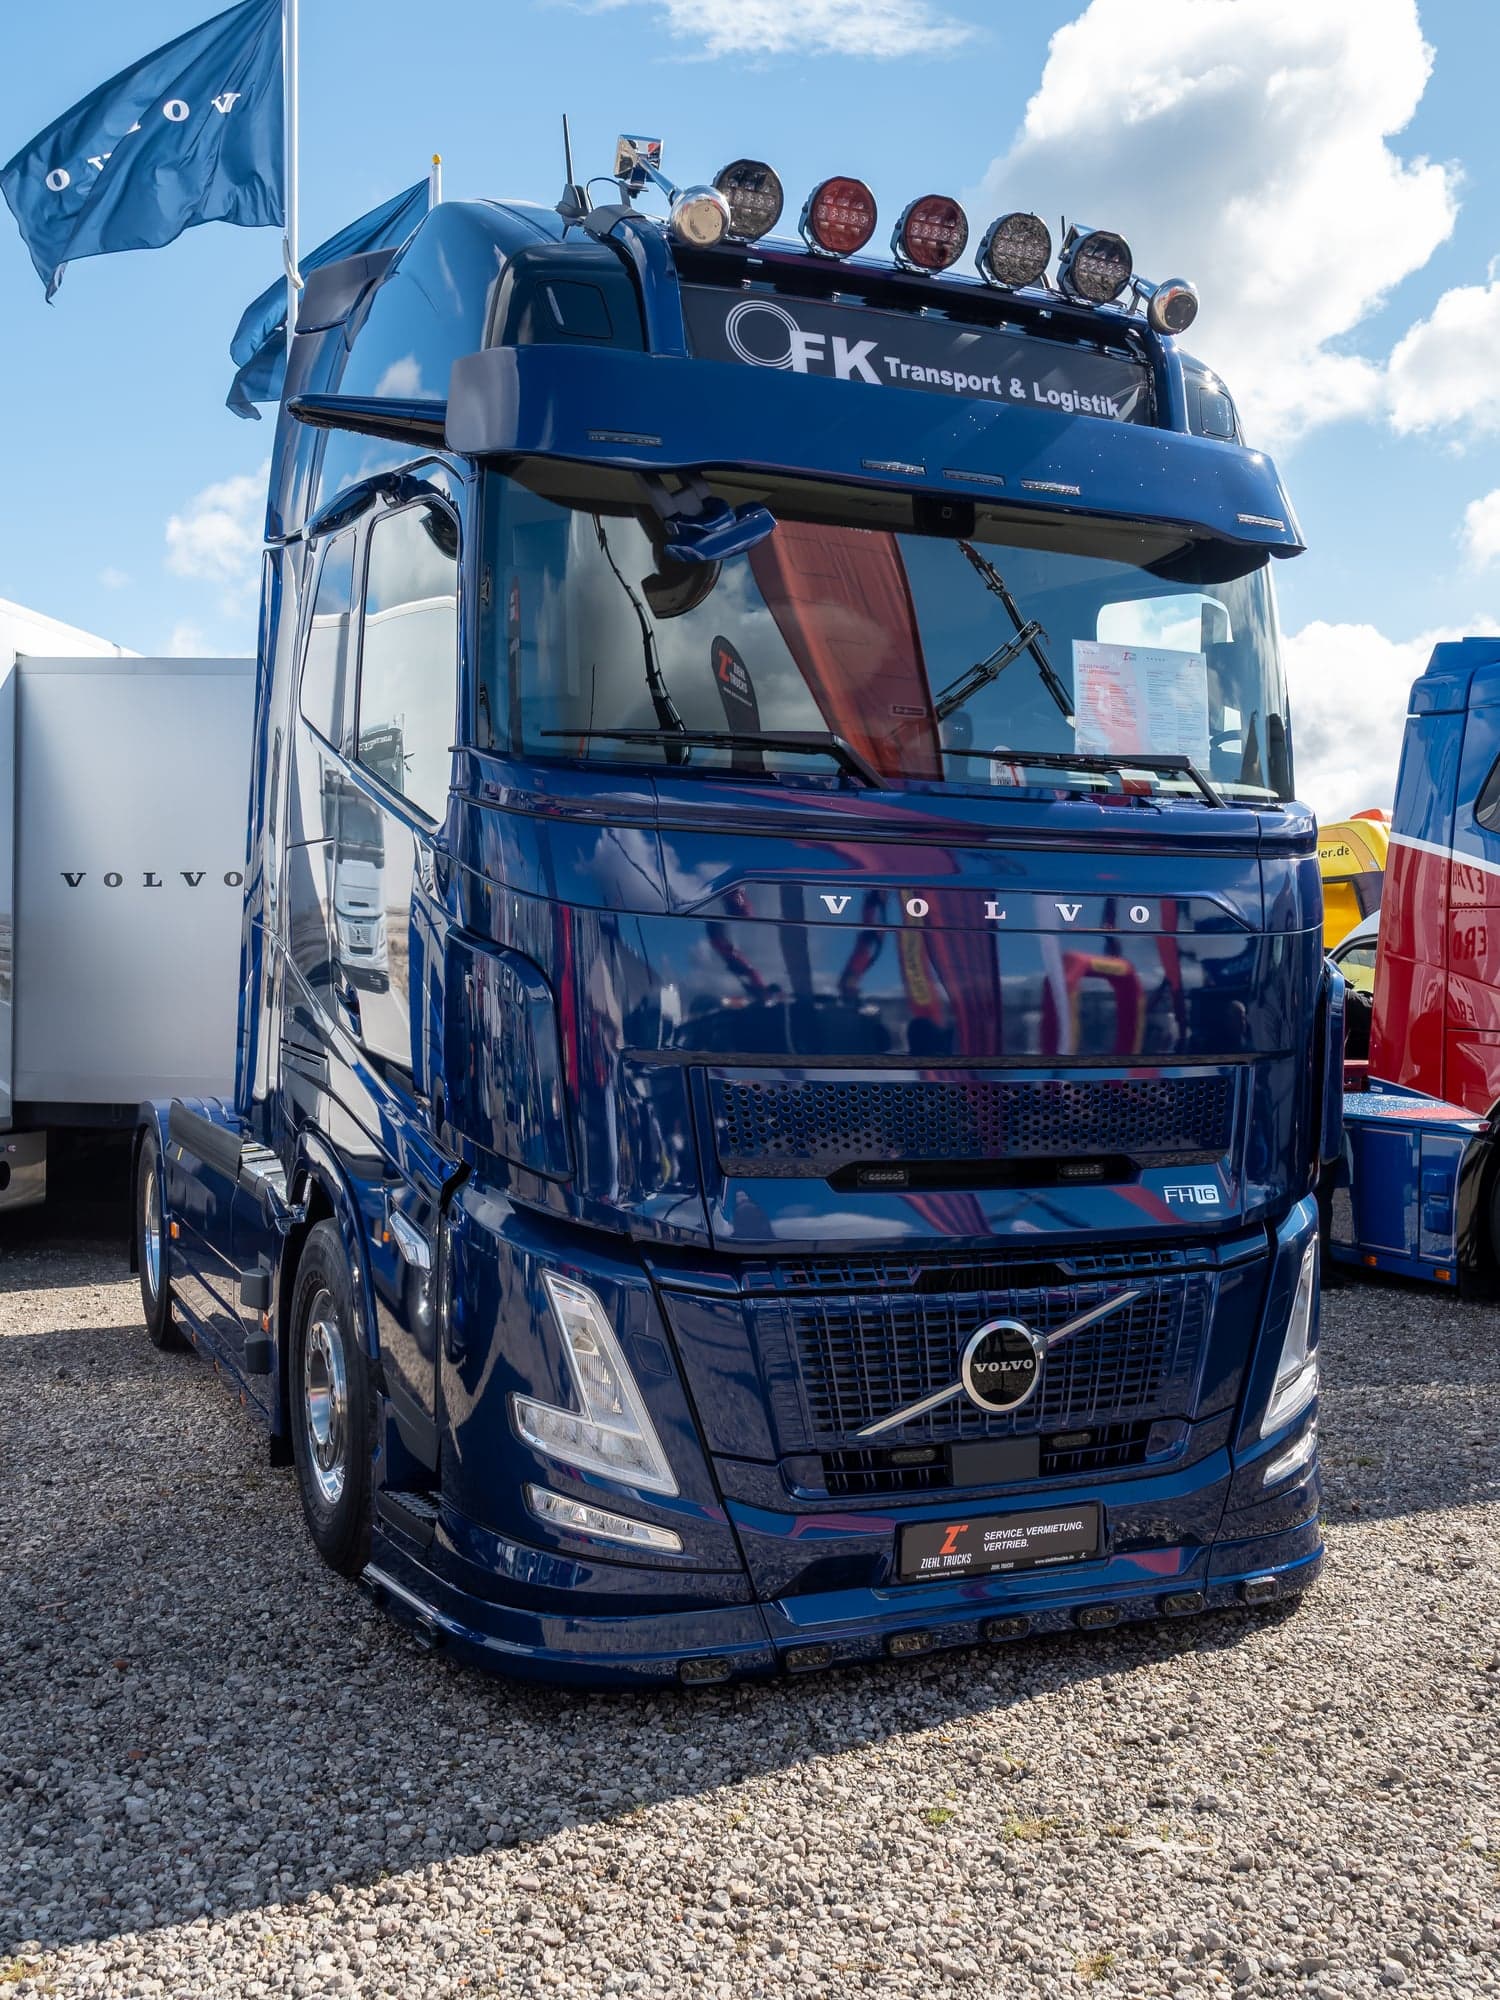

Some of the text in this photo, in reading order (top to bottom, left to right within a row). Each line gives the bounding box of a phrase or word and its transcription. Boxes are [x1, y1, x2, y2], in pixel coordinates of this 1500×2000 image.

[884, 356, 1002, 395] Transport
[1008, 378, 1027, 399] &
[1033, 382, 1121, 418] Logistik
[60, 871, 244, 888] VOLVO
[820, 894, 1150, 924] VOLVO
[973, 1359, 1034, 1373] VOLVO
[983, 1520, 1084, 1541] SERVICE. VERMIETUNG.
[983, 1538, 1030, 1552] VERTRIEB.
[920, 1552, 973, 1569] ZIEHL TRUCKS
